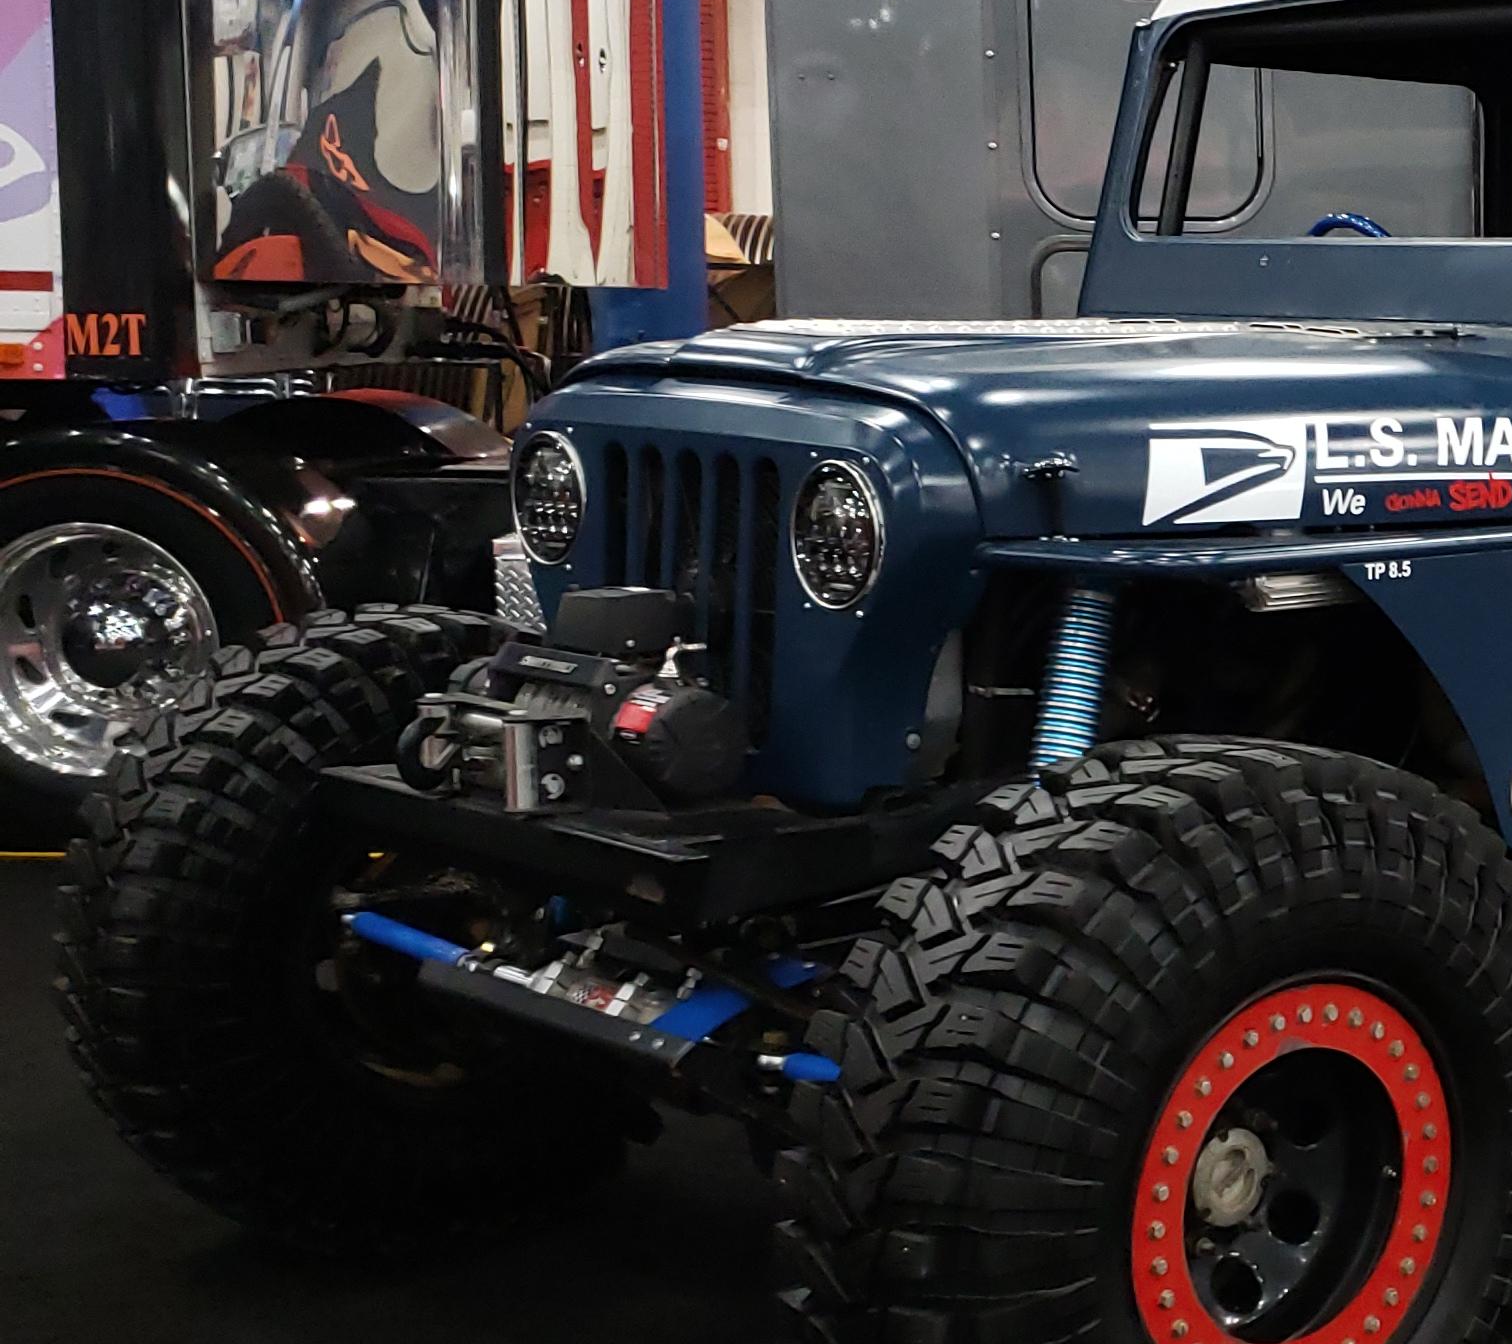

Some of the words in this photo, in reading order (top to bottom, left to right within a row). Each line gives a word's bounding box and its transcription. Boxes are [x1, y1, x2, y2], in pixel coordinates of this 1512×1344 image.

[65, 312, 147, 356] M2T
[1322, 488, 1366, 515] We
[1448, 471, 1512, 511] SEND
[1364, 562, 1386, 581] TP
[1389, 560, 1412, 578] 8.5
